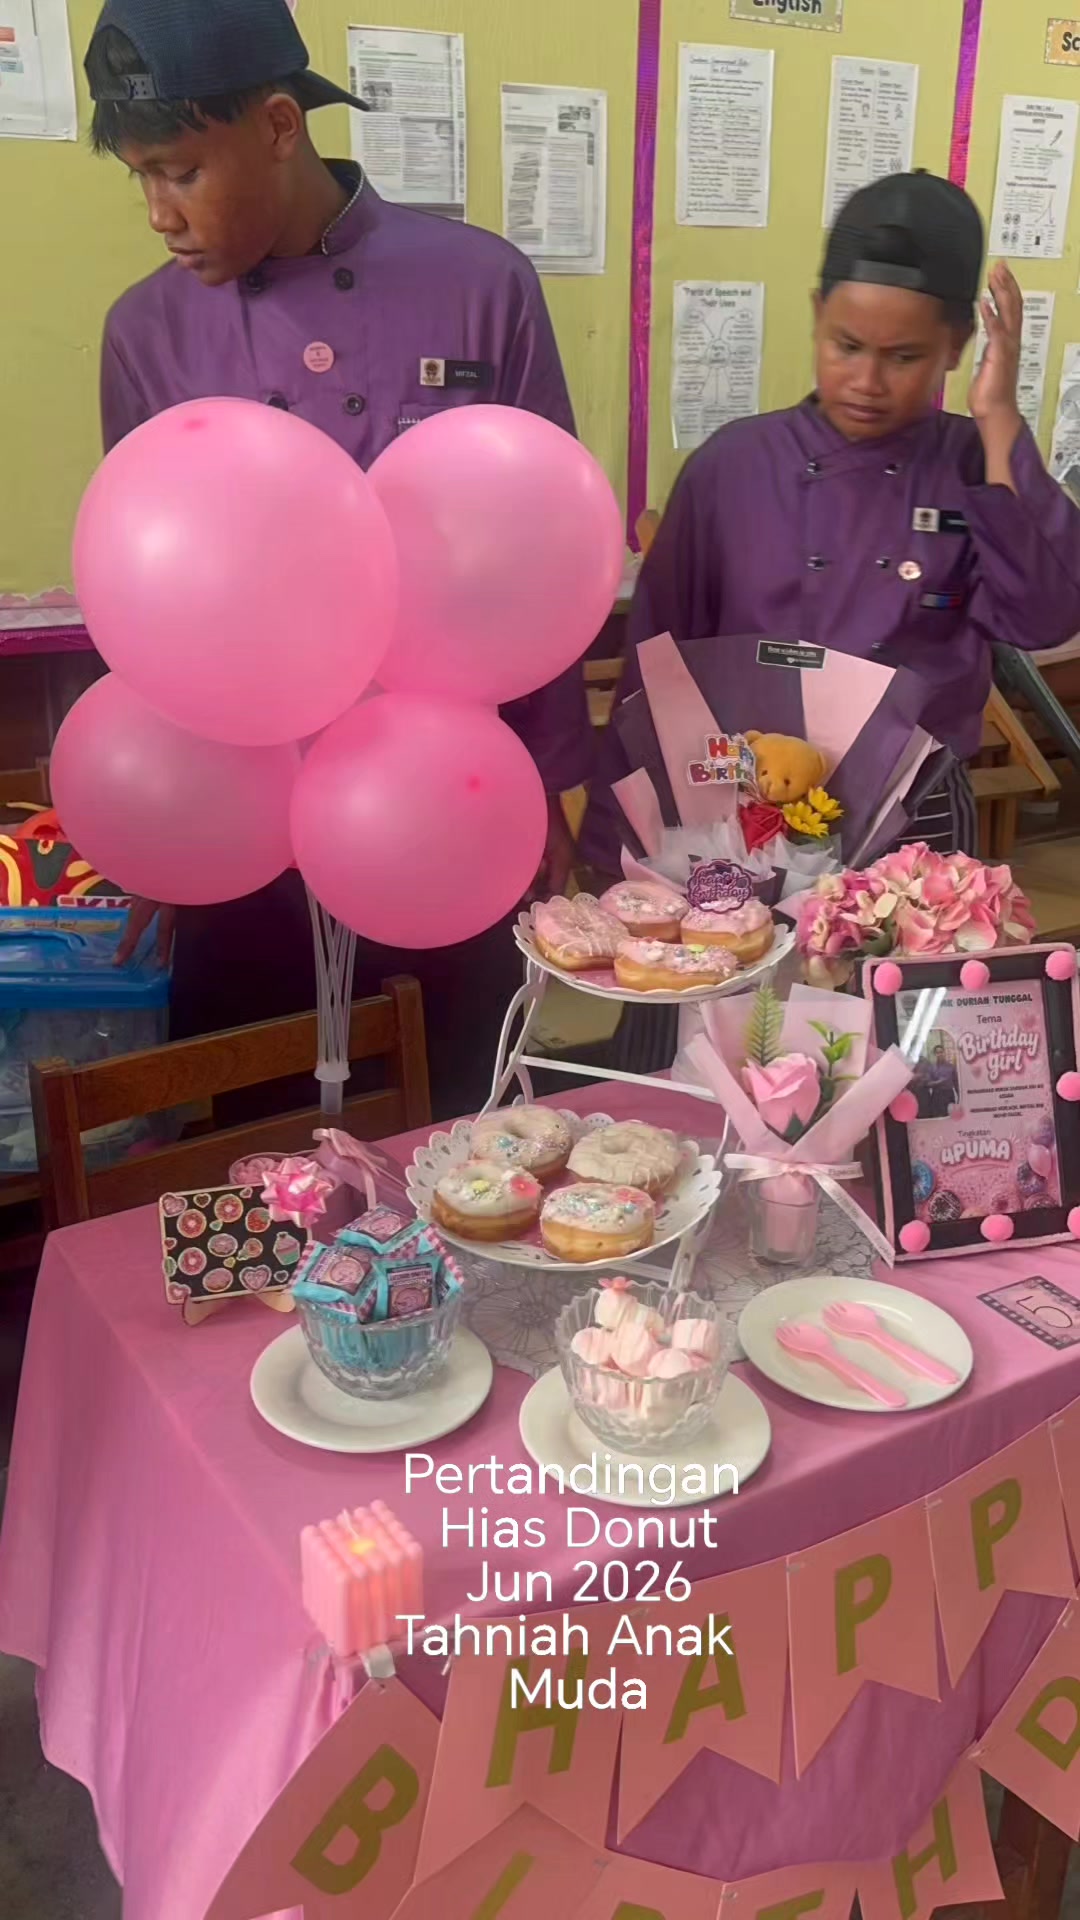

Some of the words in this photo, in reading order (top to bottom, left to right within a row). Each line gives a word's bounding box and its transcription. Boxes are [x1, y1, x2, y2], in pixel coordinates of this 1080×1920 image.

[956, 996, 990, 1007] DURIAN
[992, 993, 1033, 1004] TUNGGAL
[976, 1014, 1003, 1024] Tema
[958, 1023, 1039, 1061] Birthday
[987, 1048, 1023, 1081] girl
[956, 1129, 992, 1138] Tingkatan
[940, 1139, 1011, 1165] 4PUMA
[1015, 1295, 1073, 1329] 5
